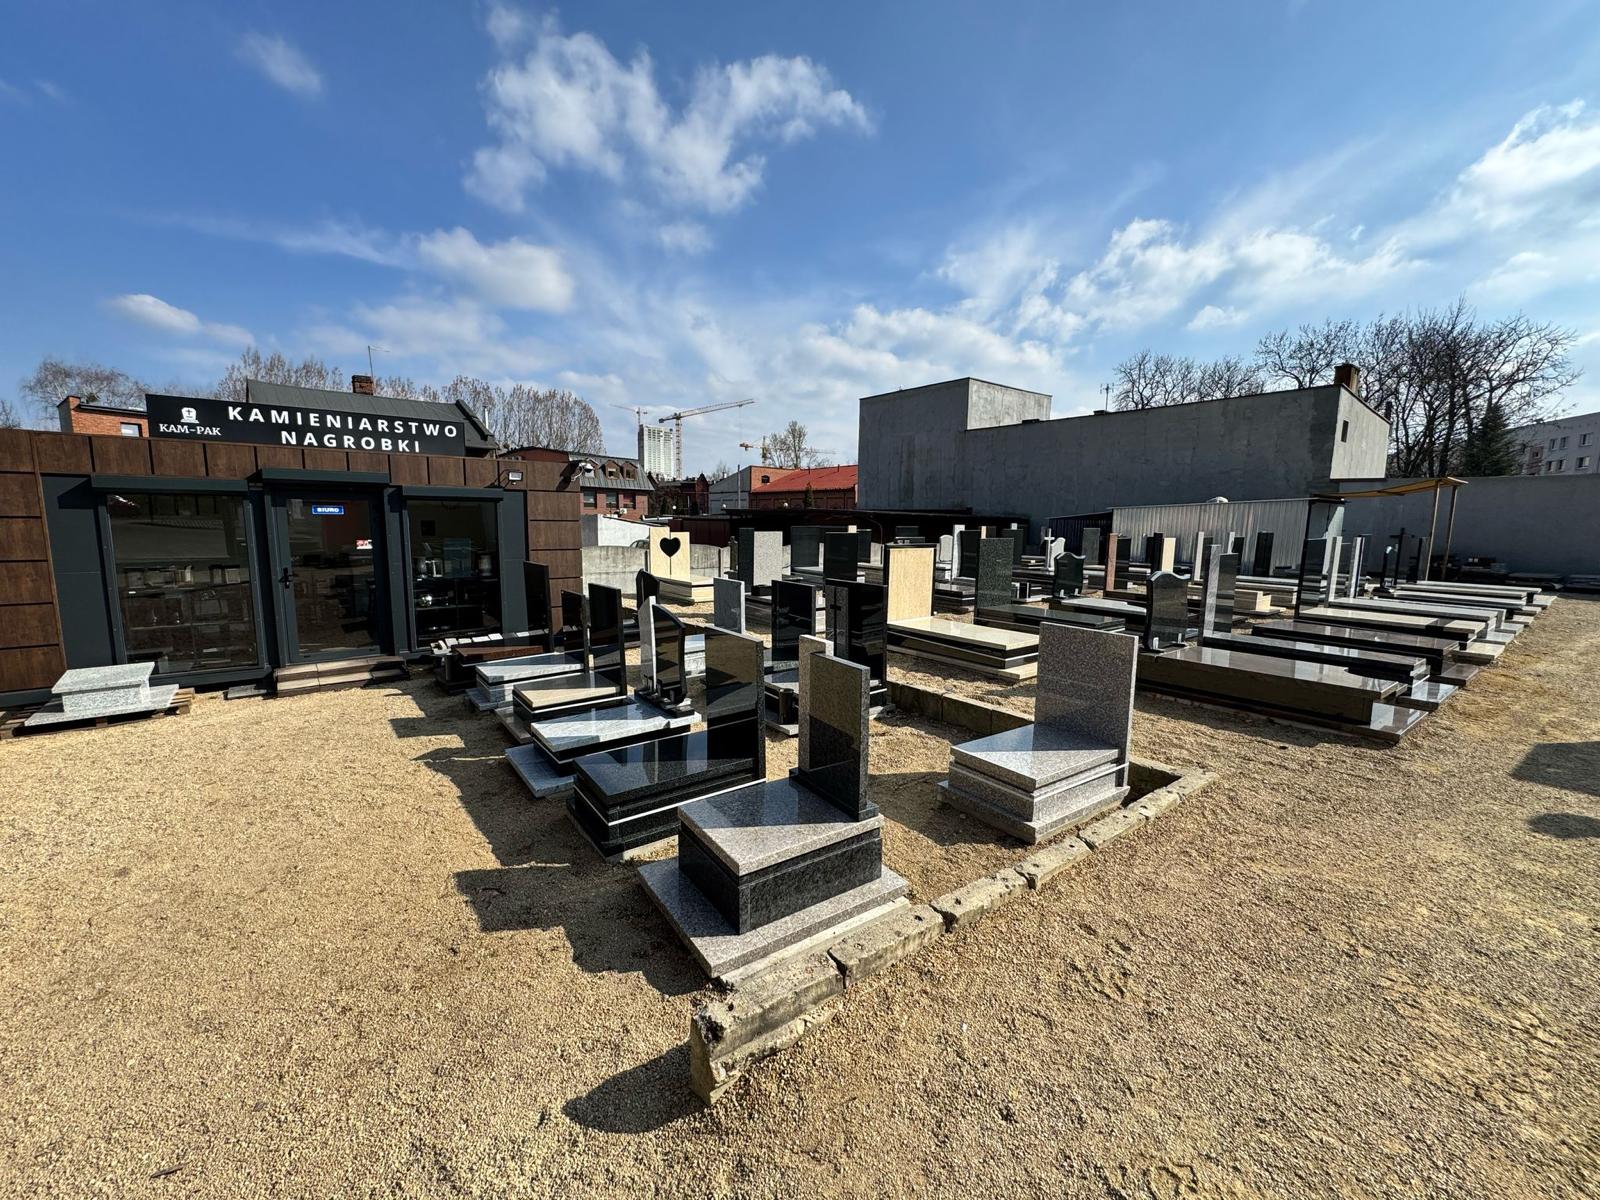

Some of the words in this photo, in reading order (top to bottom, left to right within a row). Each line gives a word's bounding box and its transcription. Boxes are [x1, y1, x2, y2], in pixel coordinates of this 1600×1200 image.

[159, 423, 221, 436] KAM-PAK
[228, 406, 457, 438] KAMIENIARSTWO
[281, 430, 420, 453] NAGROBKI
